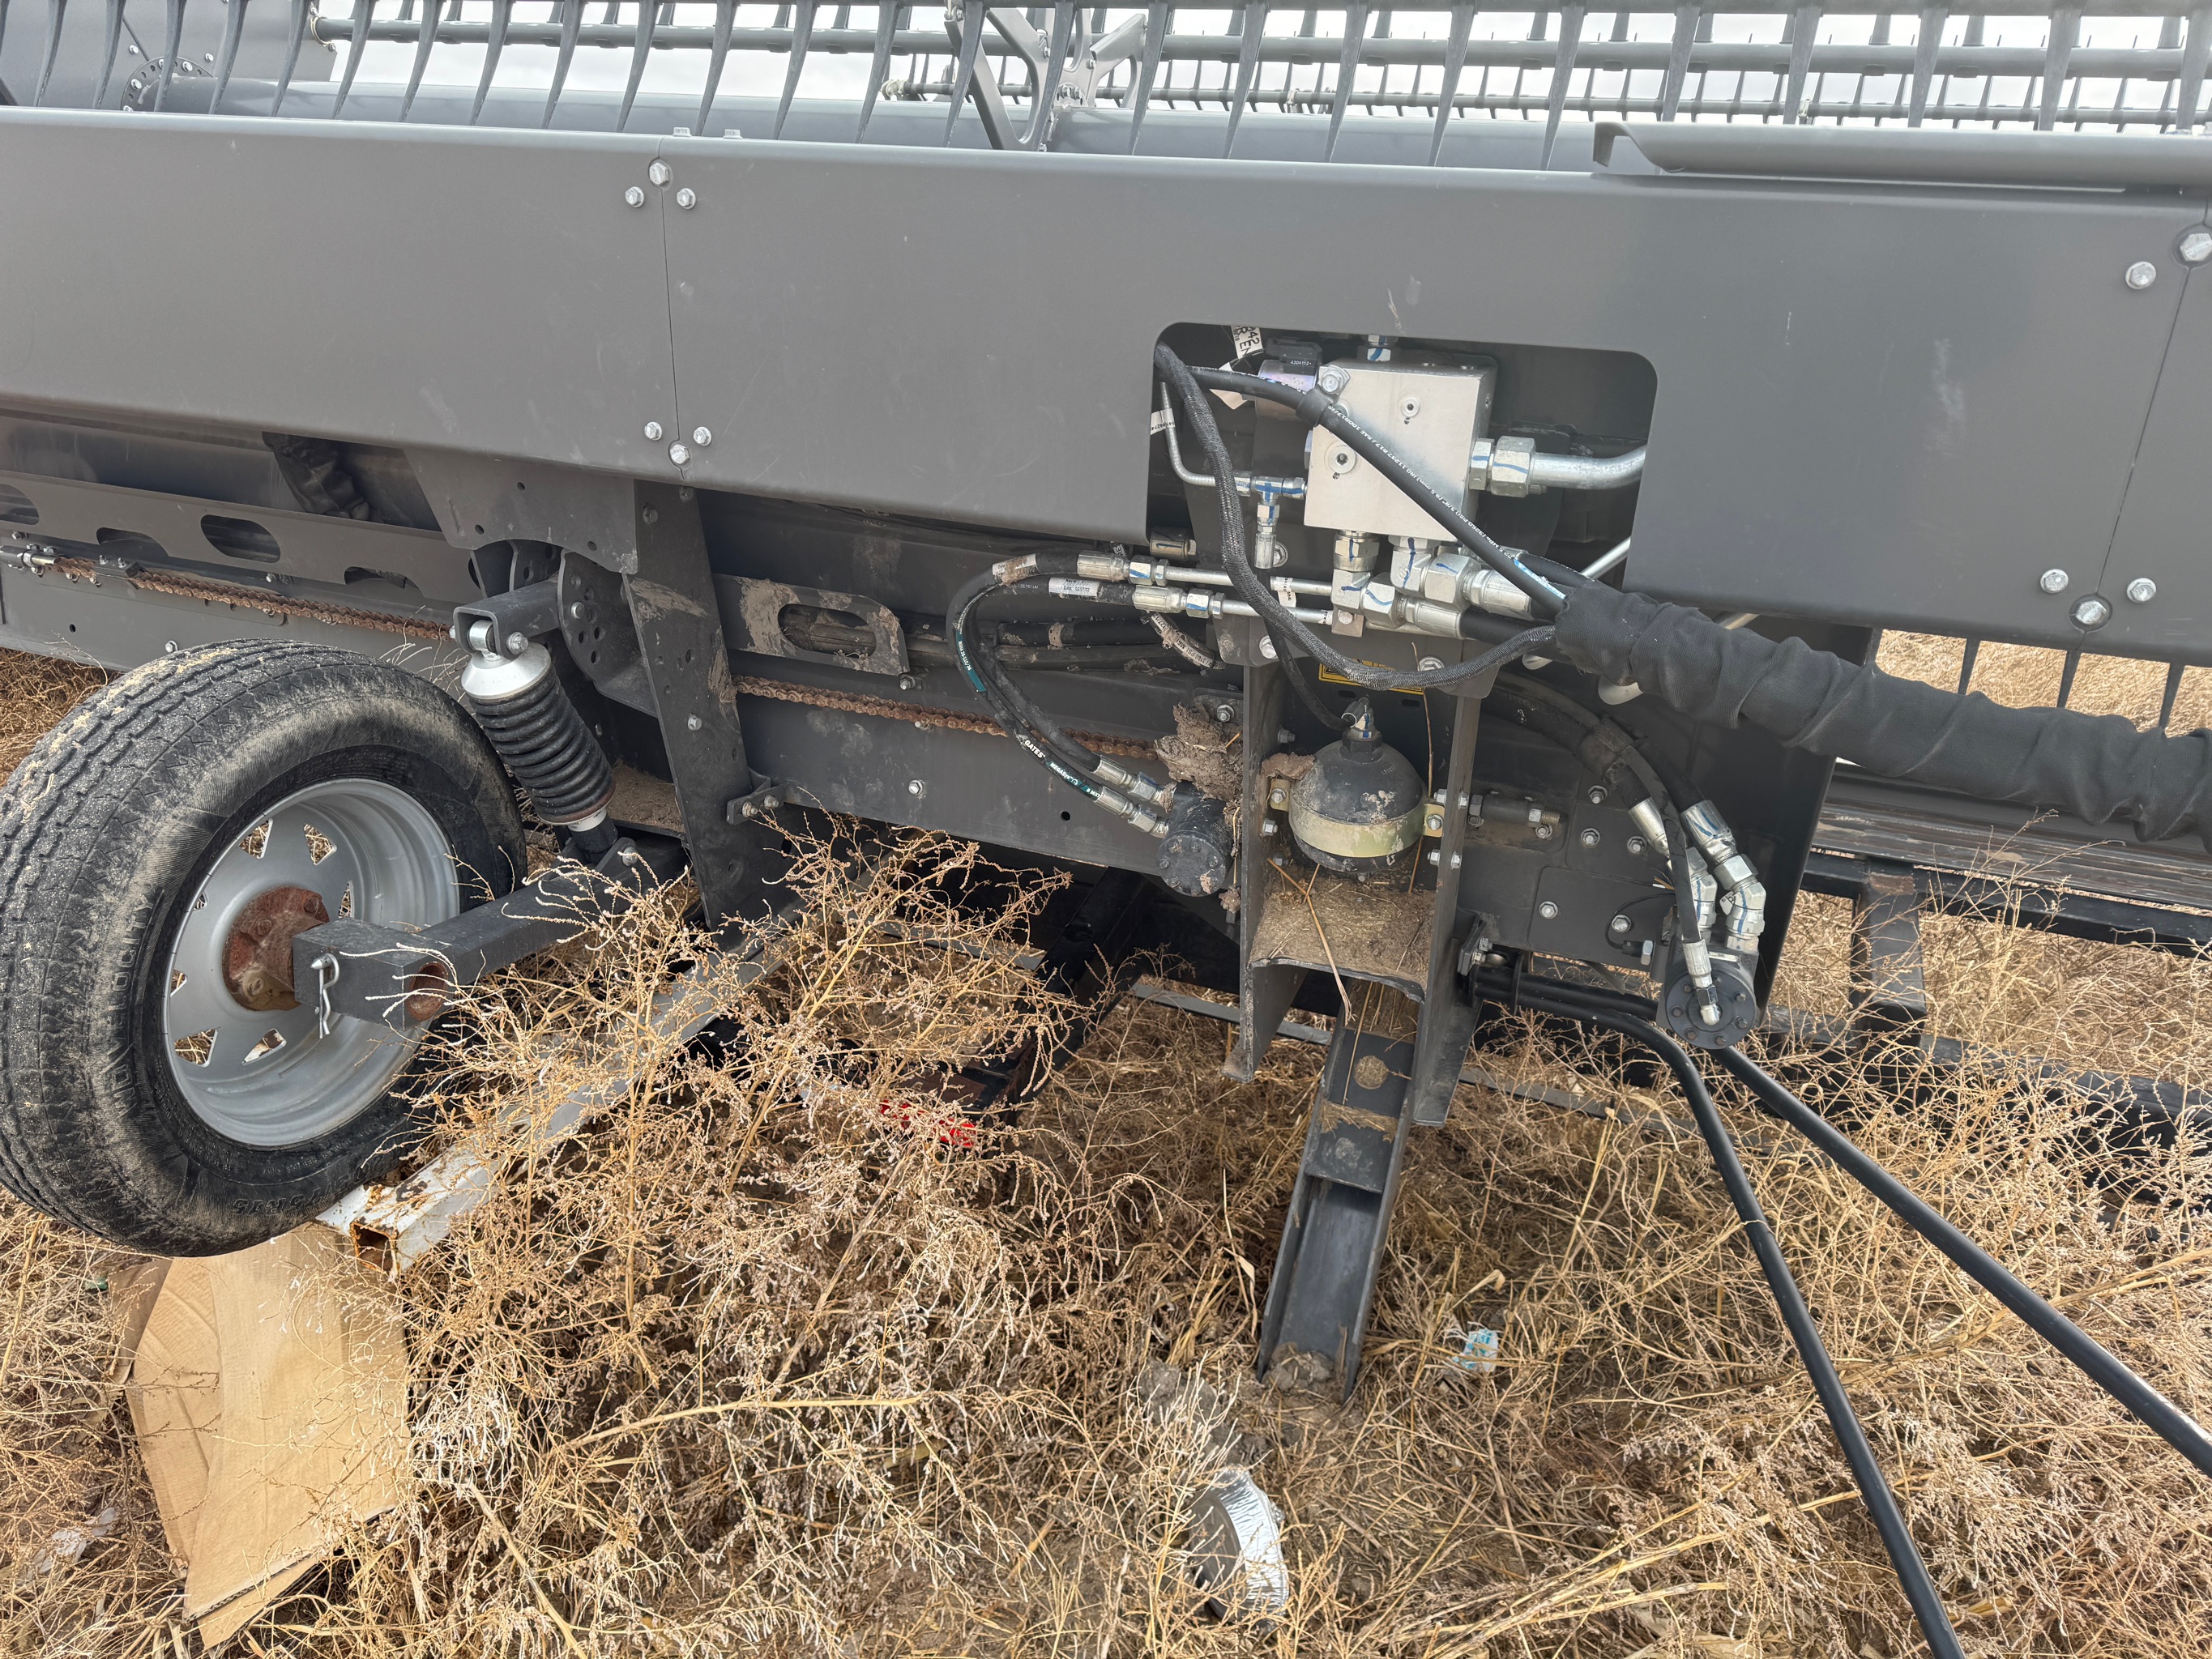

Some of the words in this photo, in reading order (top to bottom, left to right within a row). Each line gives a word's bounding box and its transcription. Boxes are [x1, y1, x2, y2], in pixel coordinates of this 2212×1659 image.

[1360, 429, 1373, 441] SAE
[1024, 740, 1045, 758] GATES
[106, 893, 154, 1056] VELOCITY
[286, 1158, 318, 1175] SERVICE
